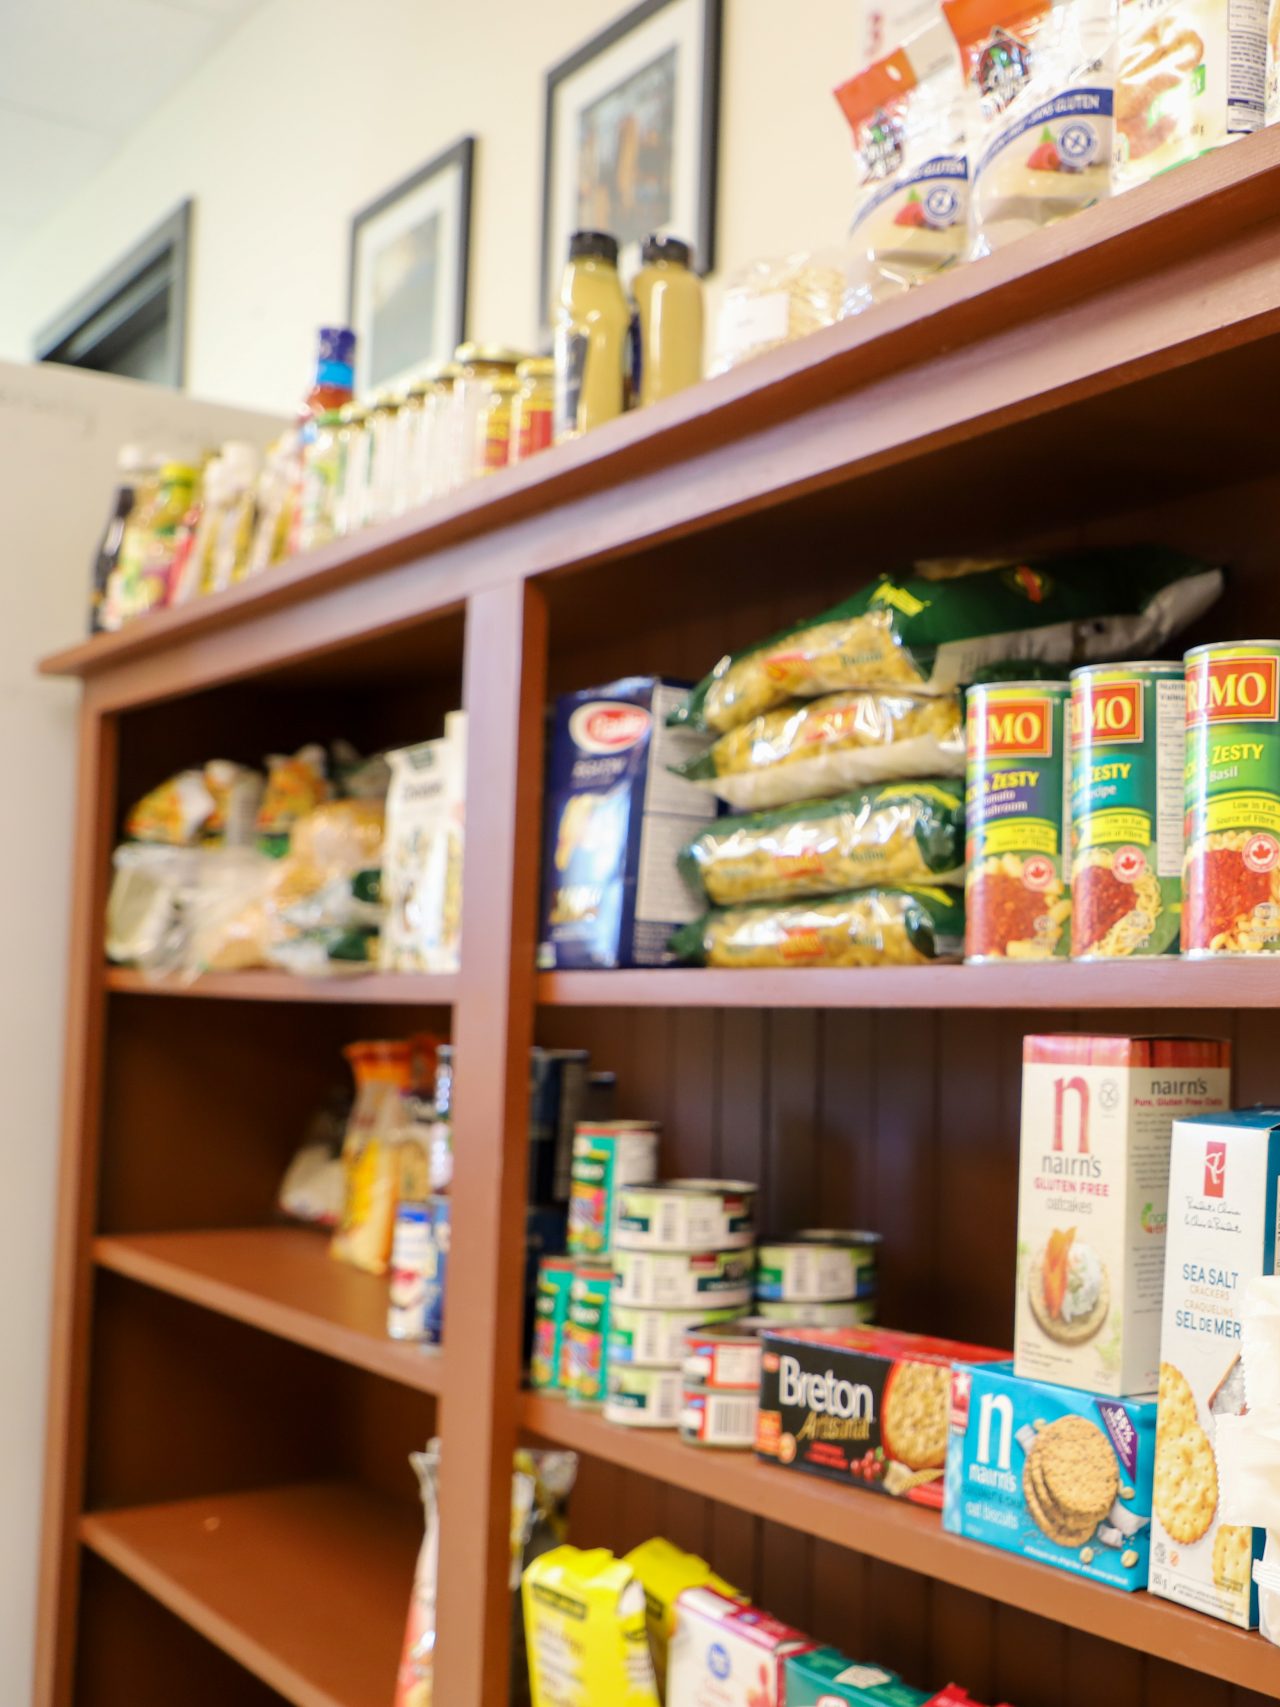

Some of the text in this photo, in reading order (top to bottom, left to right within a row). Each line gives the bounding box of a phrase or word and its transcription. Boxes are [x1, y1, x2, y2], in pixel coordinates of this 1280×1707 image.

[1212, 743, 1265, 766] ZESTY
[1209, 765, 1239, 783] Basil
[1150, 1077, 1208, 1097] nairn's
[1052, 1075, 1091, 1154] n
[1041, 1153, 1103, 1179] nairn's
[1033, 1176, 1110, 1198] GLUTEN FREE
[1182, 1263, 1239, 1290] SEA SALT
[1188, 1284, 1231, 1302] CRACKERS
[1175, 1309, 1243, 1340] SEL DE MER
[779, 1355, 874, 1423] Breton
[976, 1392, 1015, 1470] n
